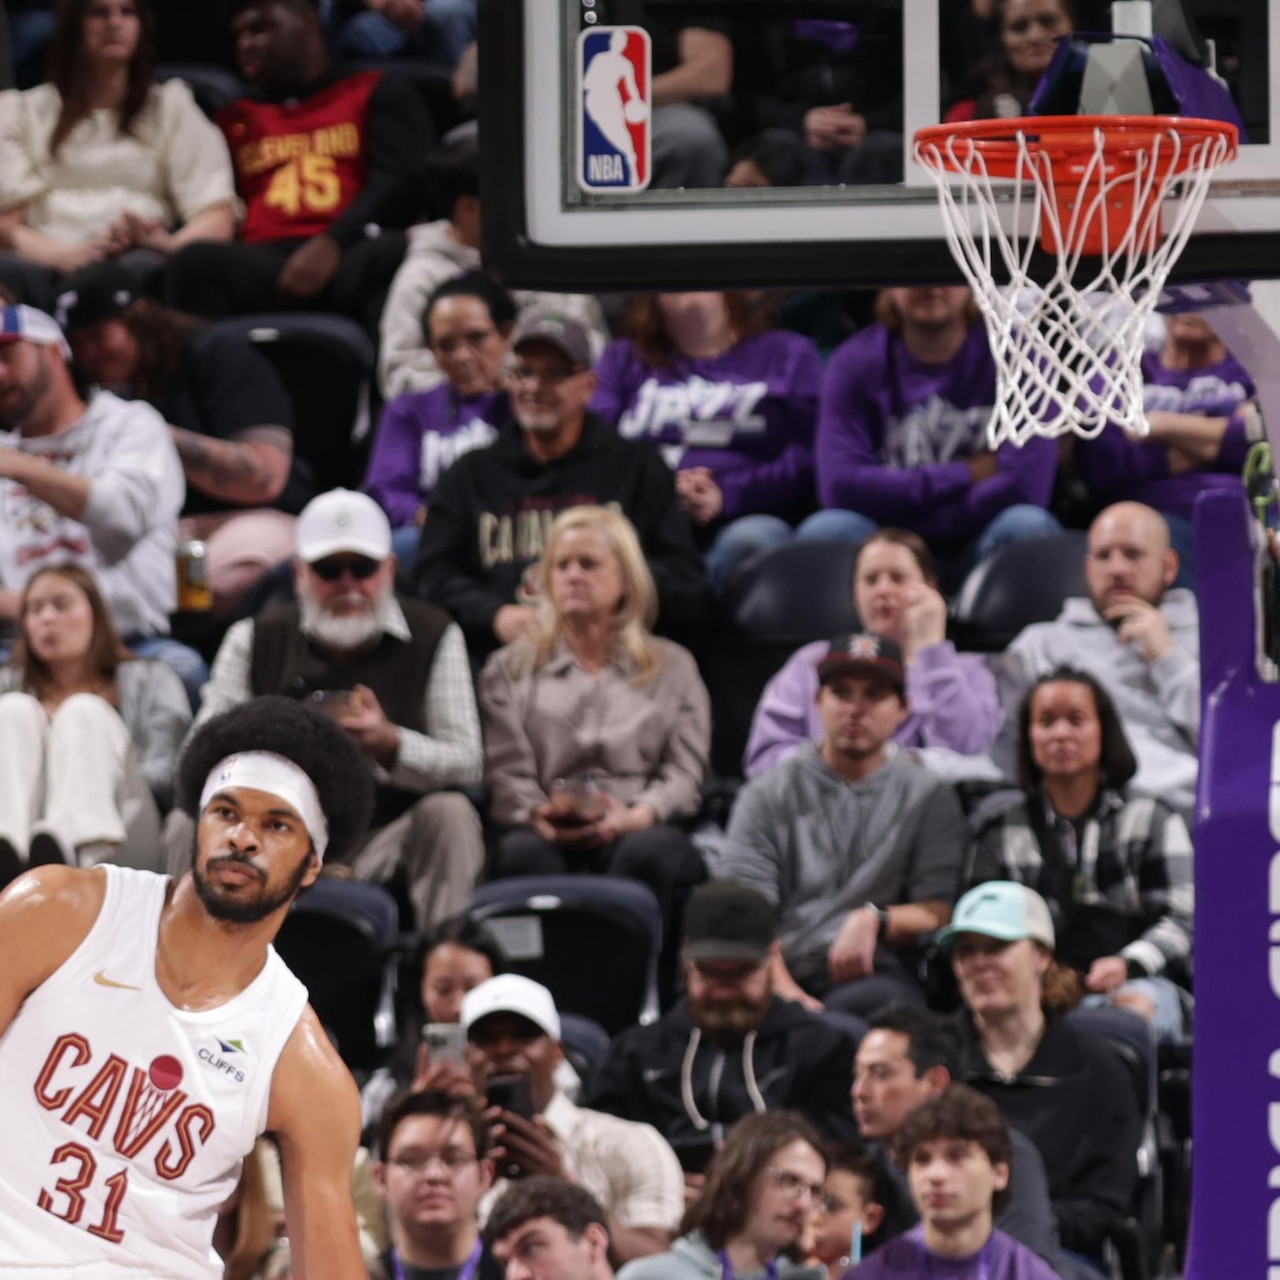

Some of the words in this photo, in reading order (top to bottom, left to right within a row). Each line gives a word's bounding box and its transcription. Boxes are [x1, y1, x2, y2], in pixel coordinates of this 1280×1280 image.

[264, 152, 341, 216] 45
[589, 154, 624, 181] NBA
[198, 1047, 246, 1083] CLIFFS
[34, 1032, 216, 1181] CAVS
[37, 1141, 128, 1244] 31
